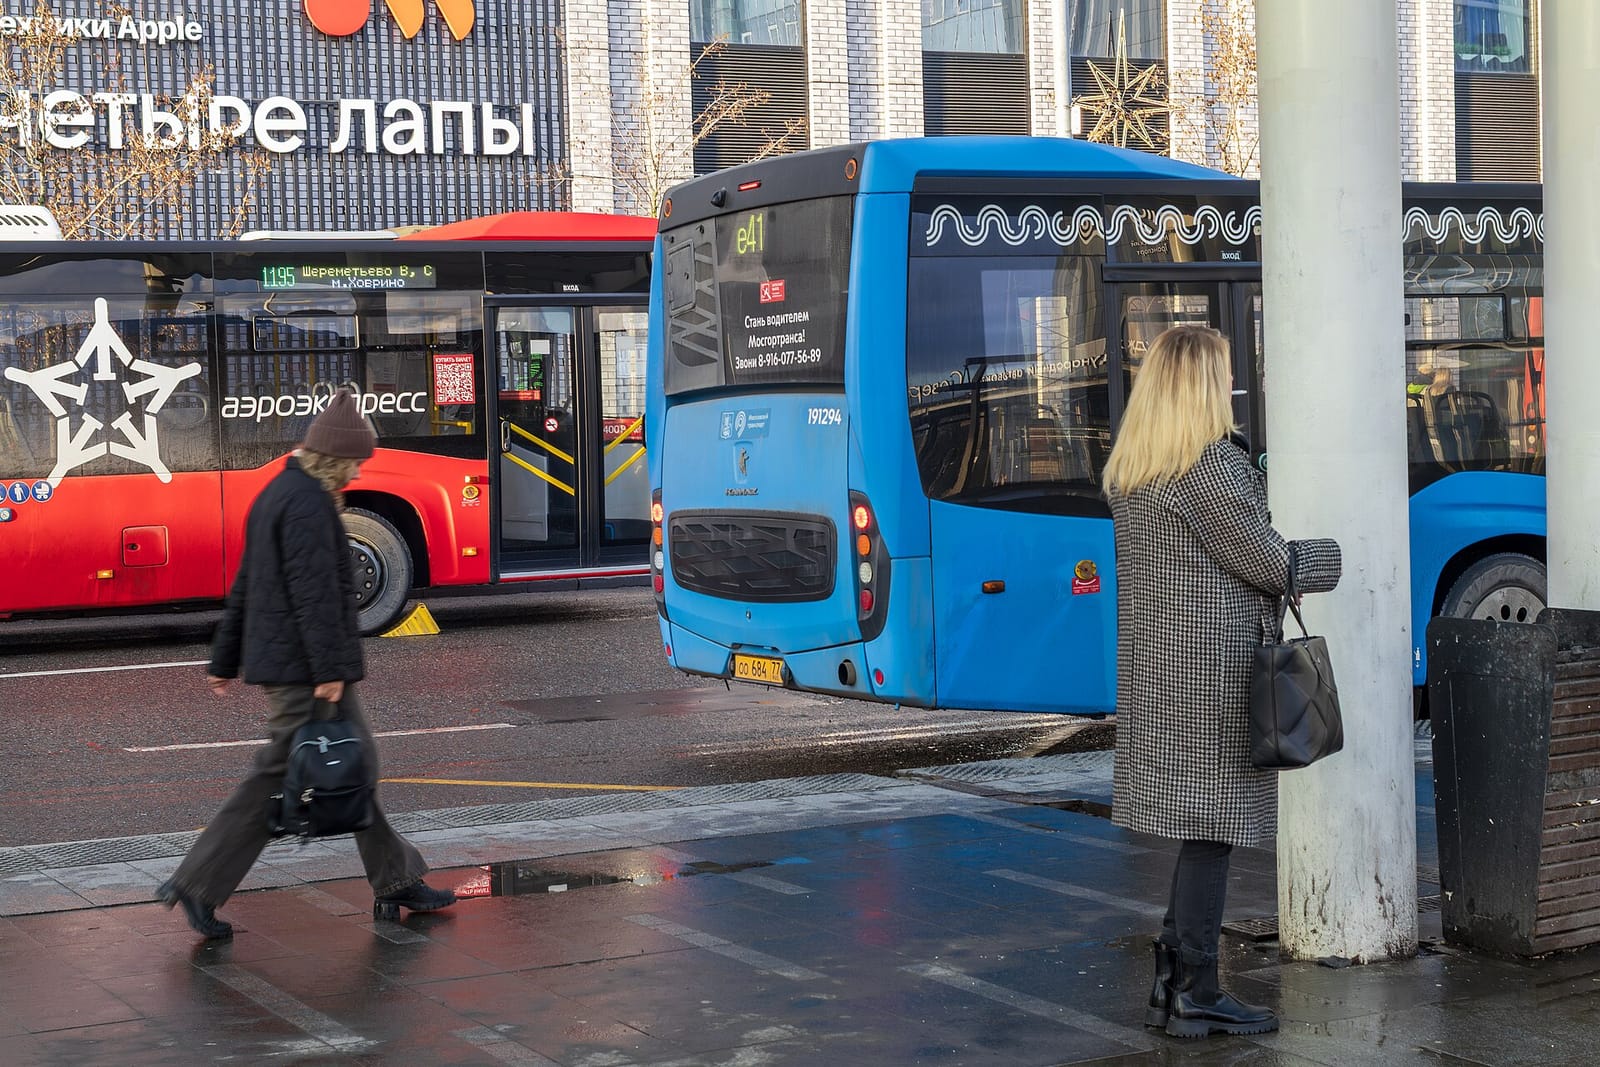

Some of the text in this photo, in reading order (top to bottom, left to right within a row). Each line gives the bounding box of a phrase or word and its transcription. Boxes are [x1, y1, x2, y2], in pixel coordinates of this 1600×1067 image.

[117, 15, 203, 45] Apple
[330, 98, 534, 156] лапы
[1221, 252, 1241, 260] ВХОД
[262, 266, 296, 288] 1195
[302, 265, 393, 278] Шереметьево
[331, 277, 406, 289] м.Ховрино
[562, 284, 580, 292] ВХОД
[744, 311, 810, 329] Стань водителем
[748, 328, 806, 349] Мосгортранса!
[735, 348, 821, 370] Звони 8-916-077-56-89
[221, 391, 428, 423] аэроэкресс
[807, 408, 842, 425] 191294
[751, 660, 767, 678] 684
[771, 661, 781, 676] 77
